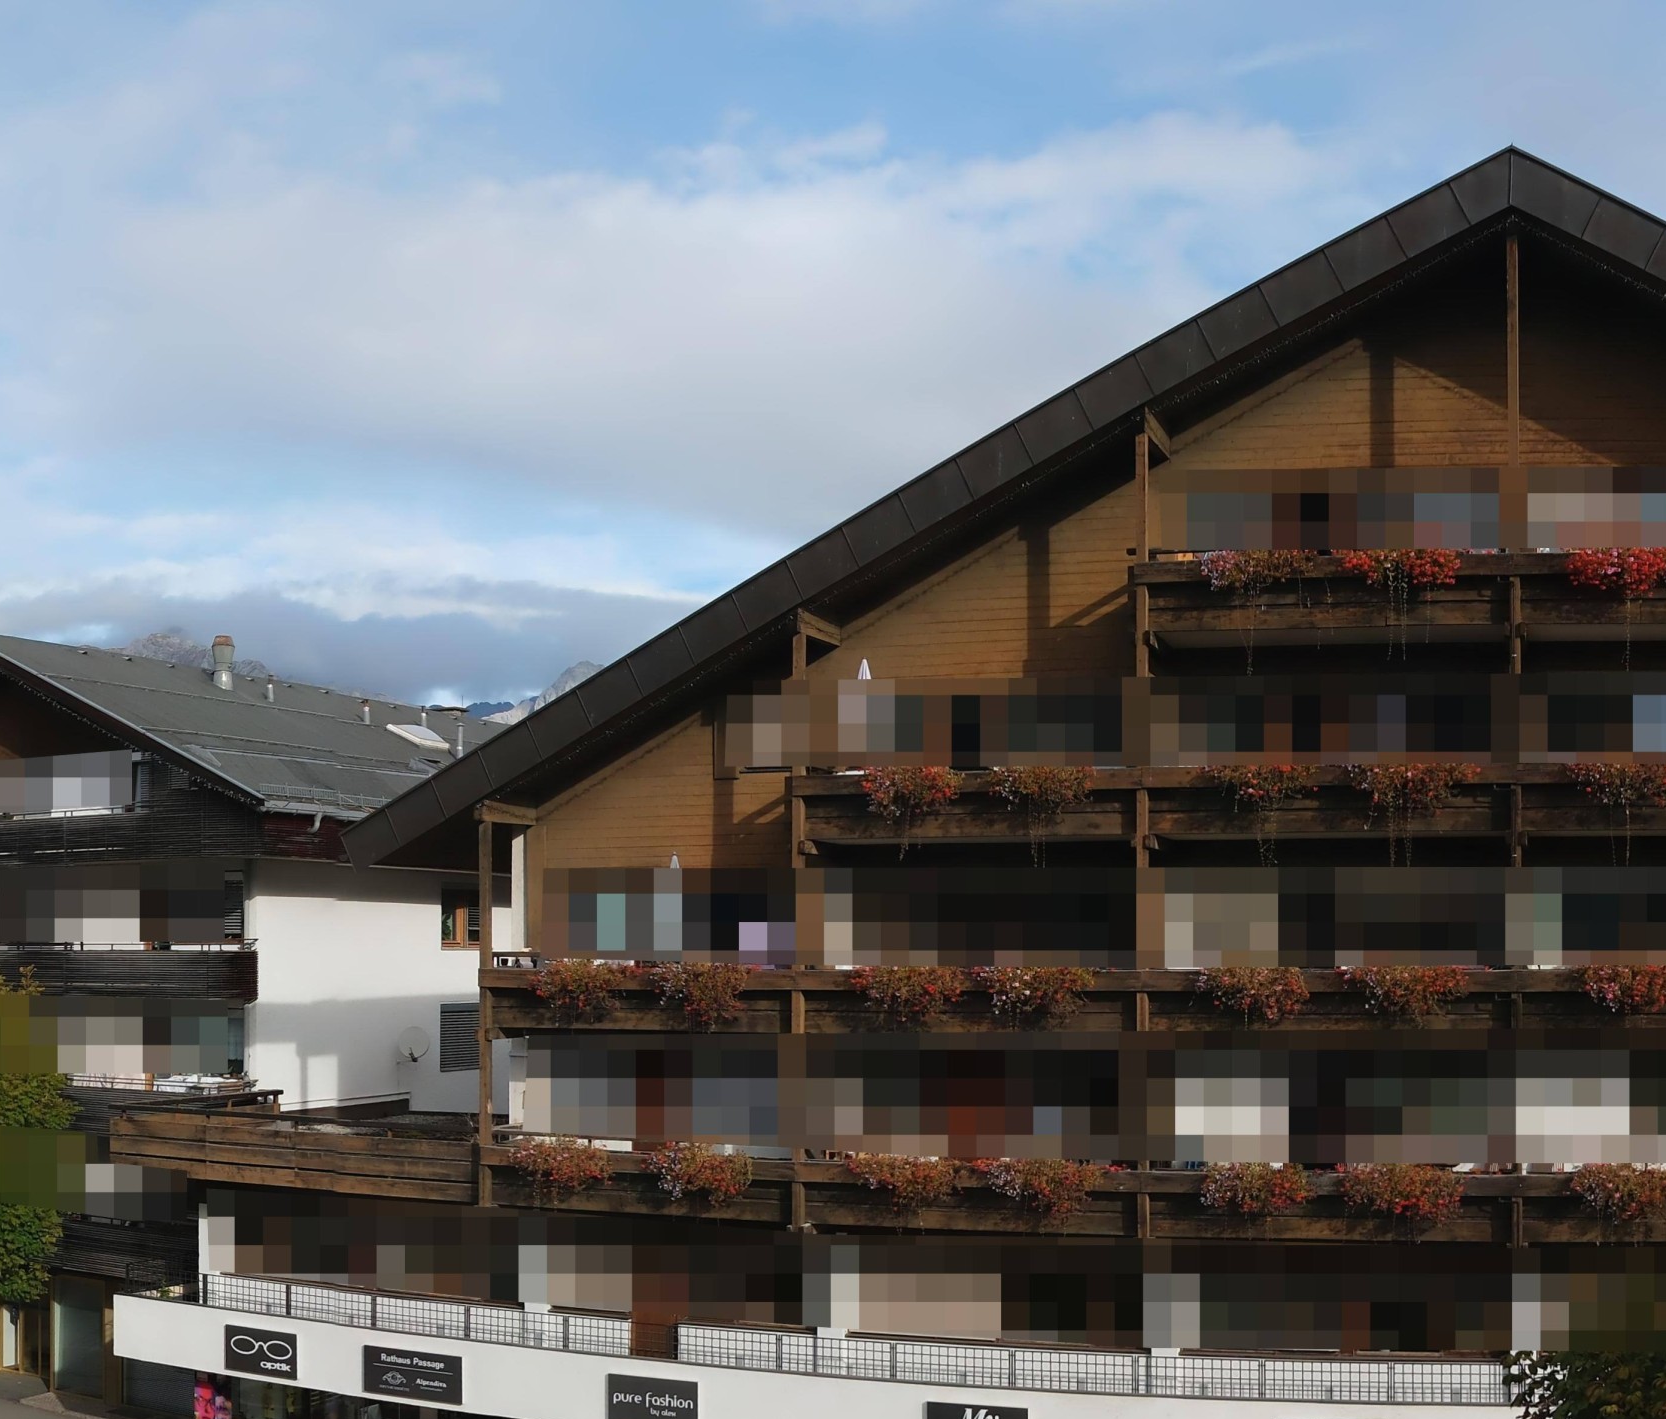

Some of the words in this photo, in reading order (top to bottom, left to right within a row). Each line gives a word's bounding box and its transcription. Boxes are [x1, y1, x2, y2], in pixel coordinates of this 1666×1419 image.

[260, 1360, 292, 1372] optik
[381, 1353, 411, 1365] Rathaus
[413, 1357, 445, 1370] Passage
[613, 1392, 642, 1404] pure
[645, 1392, 694, 1410] fashion
[650, 1407, 660, 1417] by
